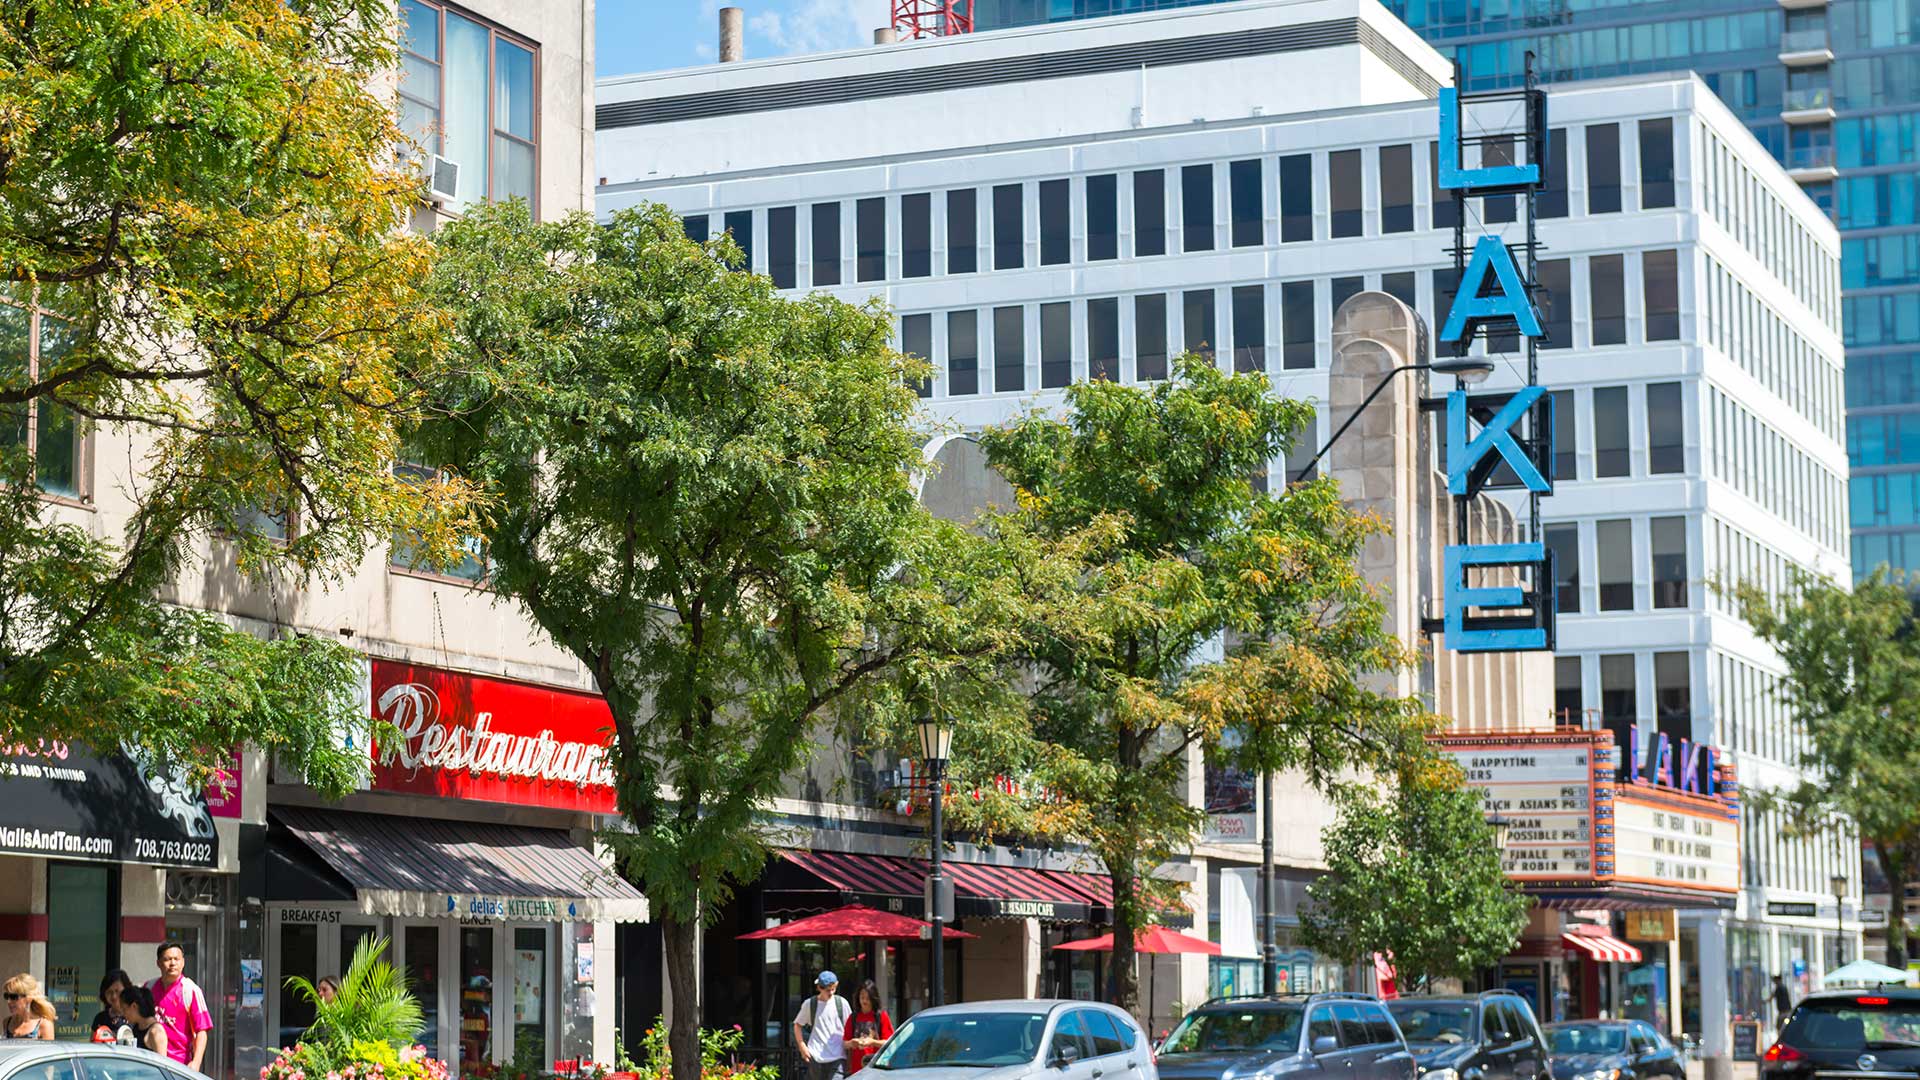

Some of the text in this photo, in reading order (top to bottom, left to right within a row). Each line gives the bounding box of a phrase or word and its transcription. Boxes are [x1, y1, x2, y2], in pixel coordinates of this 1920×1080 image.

[1438, 87, 1550, 652] LAKE
[1472, 757, 1536, 767] HAPPYTIME
[20, 763, 42, 778] AND
[42, 766, 87, 783] TANNING
[1485, 800, 1511, 810] RICH
[1519, 799, 1557, 809] ASIANS
[134, 838, 211, 862] 708.763.0292
[1510, 849, 1548, 860] FINALE
[1522, 861, 1558, 871] ROBIN
[281, 908, 341, 923] BREAKFAST
[470, 899, 556, 917] delia's KITCHEN
